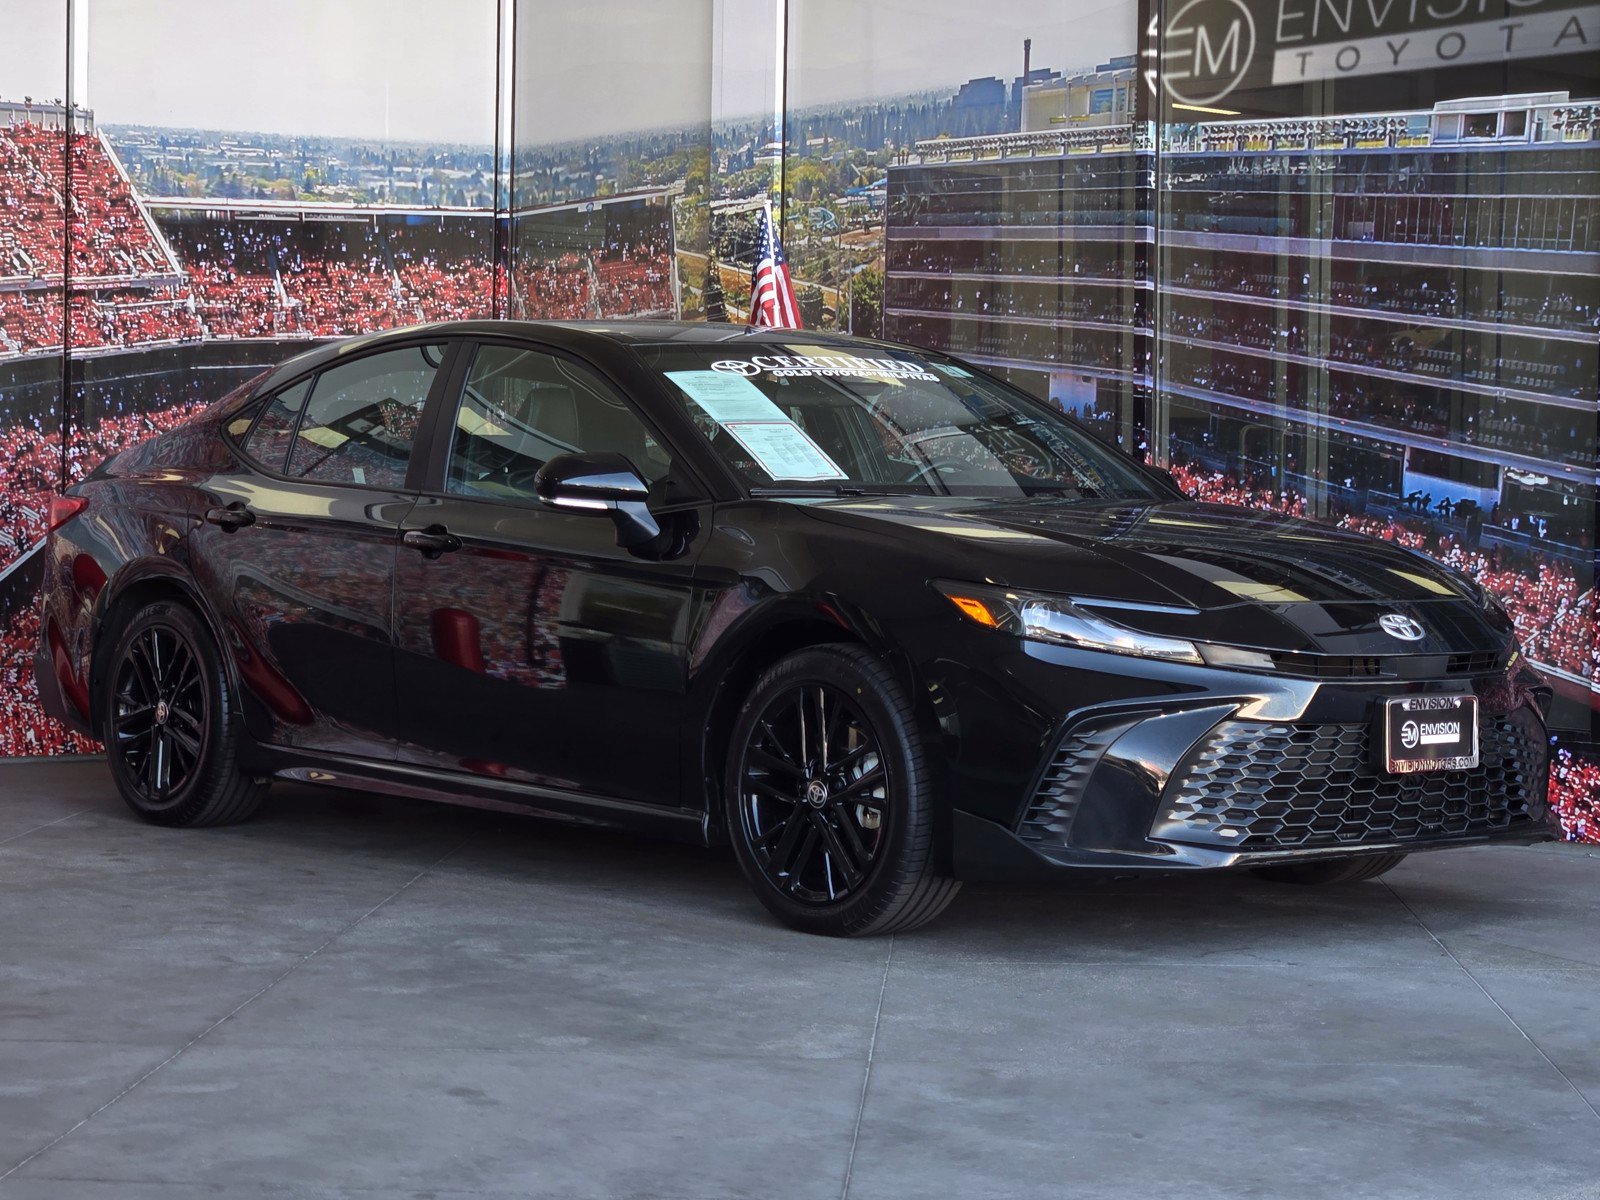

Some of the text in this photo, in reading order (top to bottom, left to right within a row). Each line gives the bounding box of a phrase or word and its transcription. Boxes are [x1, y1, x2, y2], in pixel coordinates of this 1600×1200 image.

[1296, 15, 1588, 77] TOYOTA
[750, 355, 925, 373] CERTIFIED
[772, 369, 812, 377] GOLD
[811, 369, 867, 378] TOYOTA
[1410, 698, 1454, 710] ENVISION
[1420, 722, 1460, 736] ENVISION
